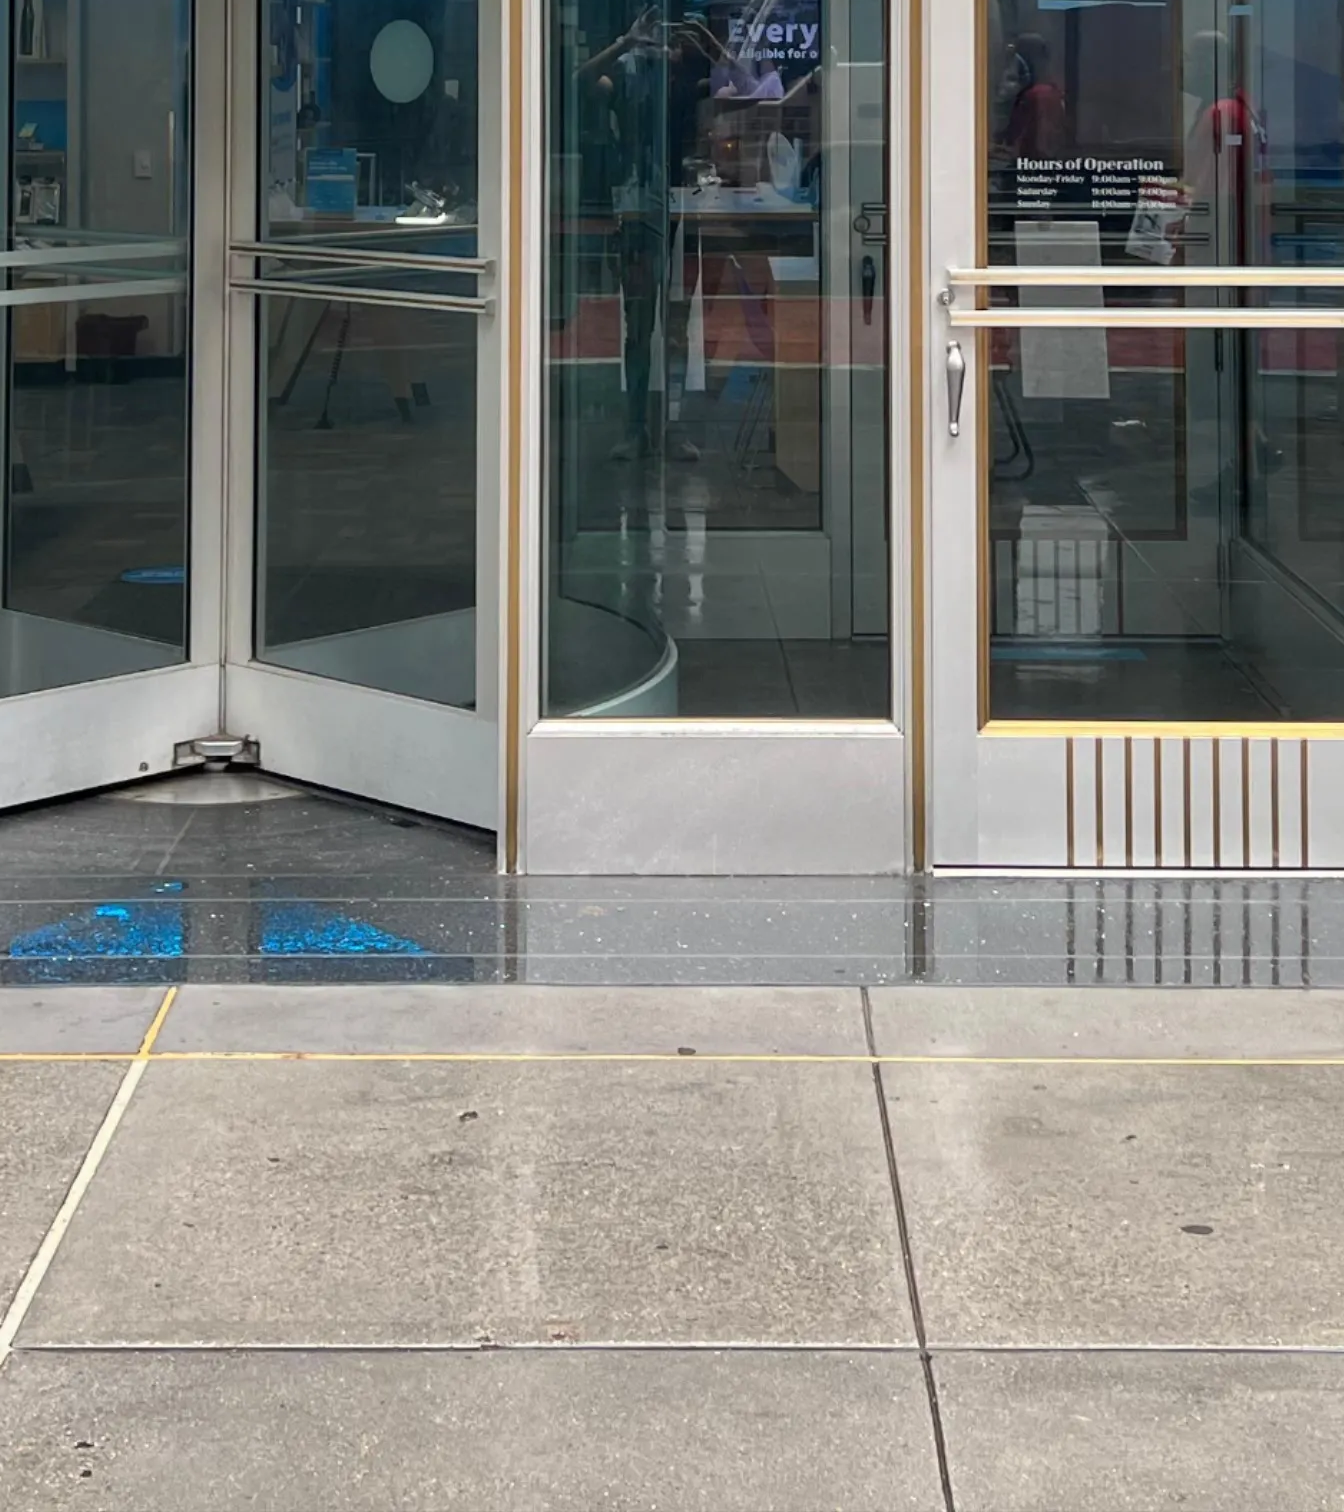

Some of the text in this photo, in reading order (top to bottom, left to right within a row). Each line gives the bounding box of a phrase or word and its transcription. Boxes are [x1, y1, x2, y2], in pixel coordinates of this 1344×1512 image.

[729, 18, 818, 49] Every
[787, 48, 807, 59] for
[1017, 157, 1164, 173] Hours of Operation
